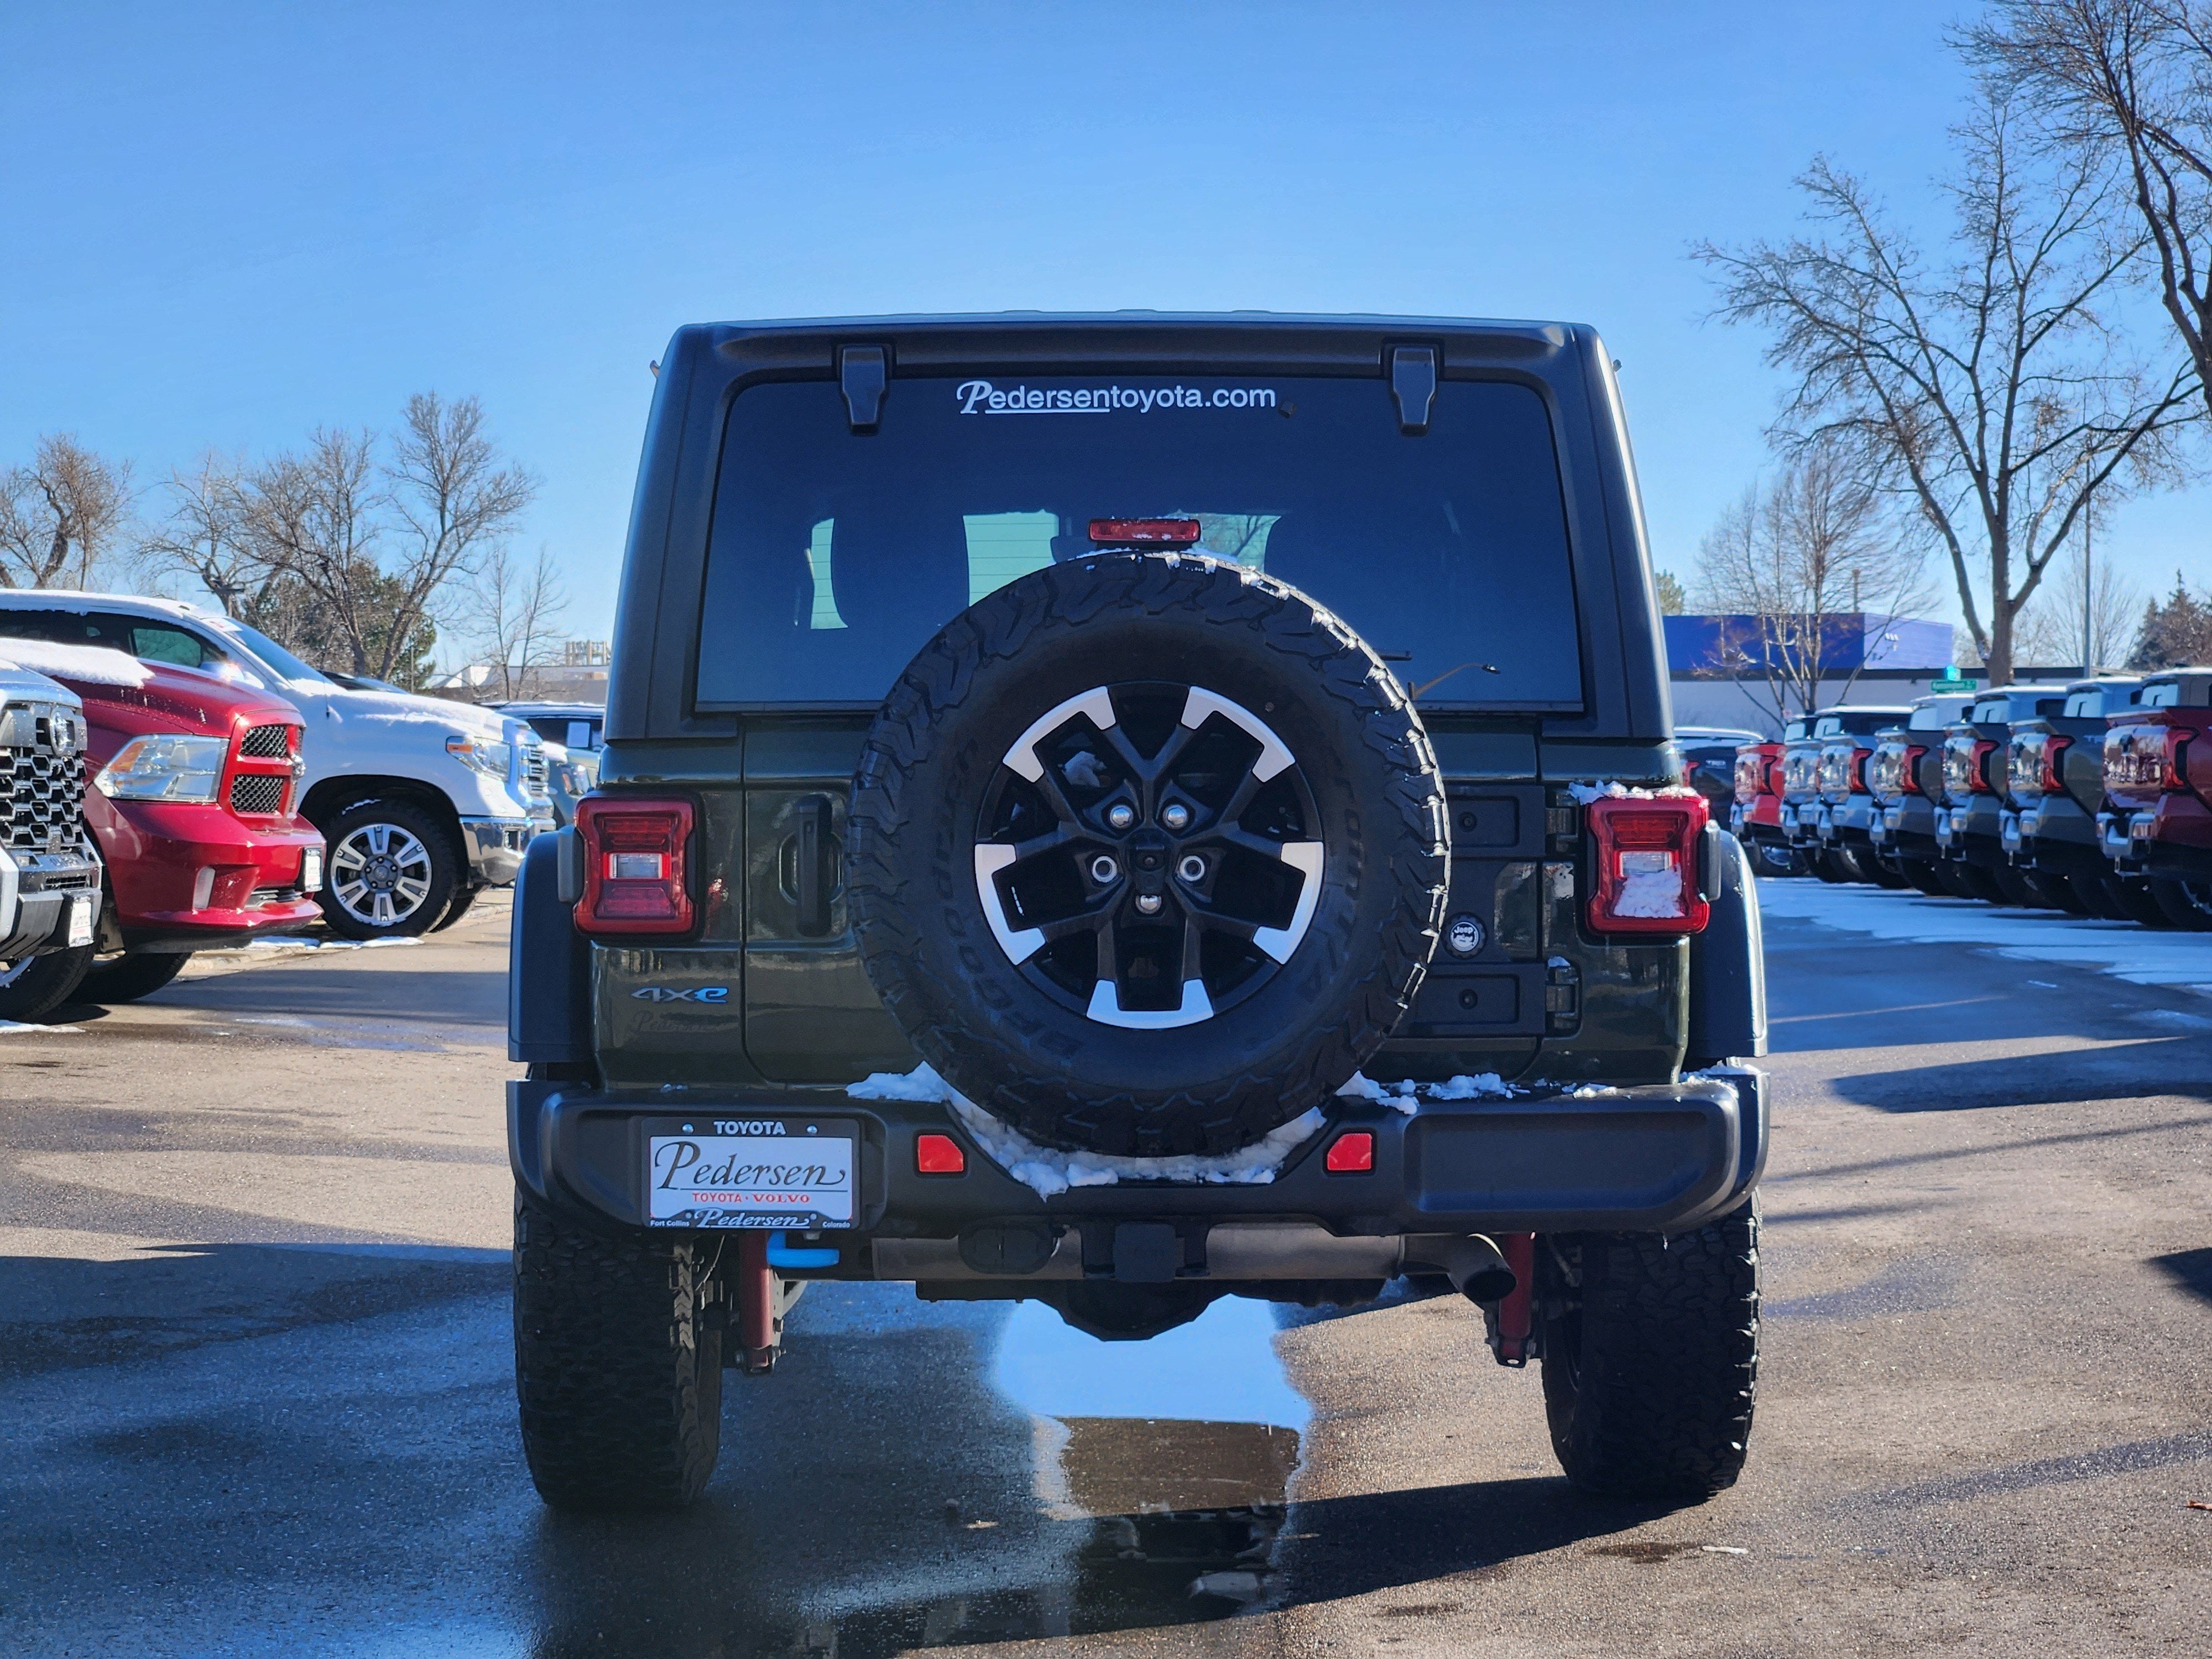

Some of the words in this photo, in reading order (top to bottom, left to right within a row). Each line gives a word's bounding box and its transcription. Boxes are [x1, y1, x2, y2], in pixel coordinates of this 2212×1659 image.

[956, 380, 1276, 414] Pedersentoyota.com
[1454, 926, 1474, 935] Jeep
[713, 1121, 786, 1135] TOYOTA
[655, 1141, 846, 1190] Pedersen
[693, 1193, 742, 1203] TOYOTA
[751, 1193, 811, 1203] VOLVO
[694, 1207, 810, 1228] Pedersen
